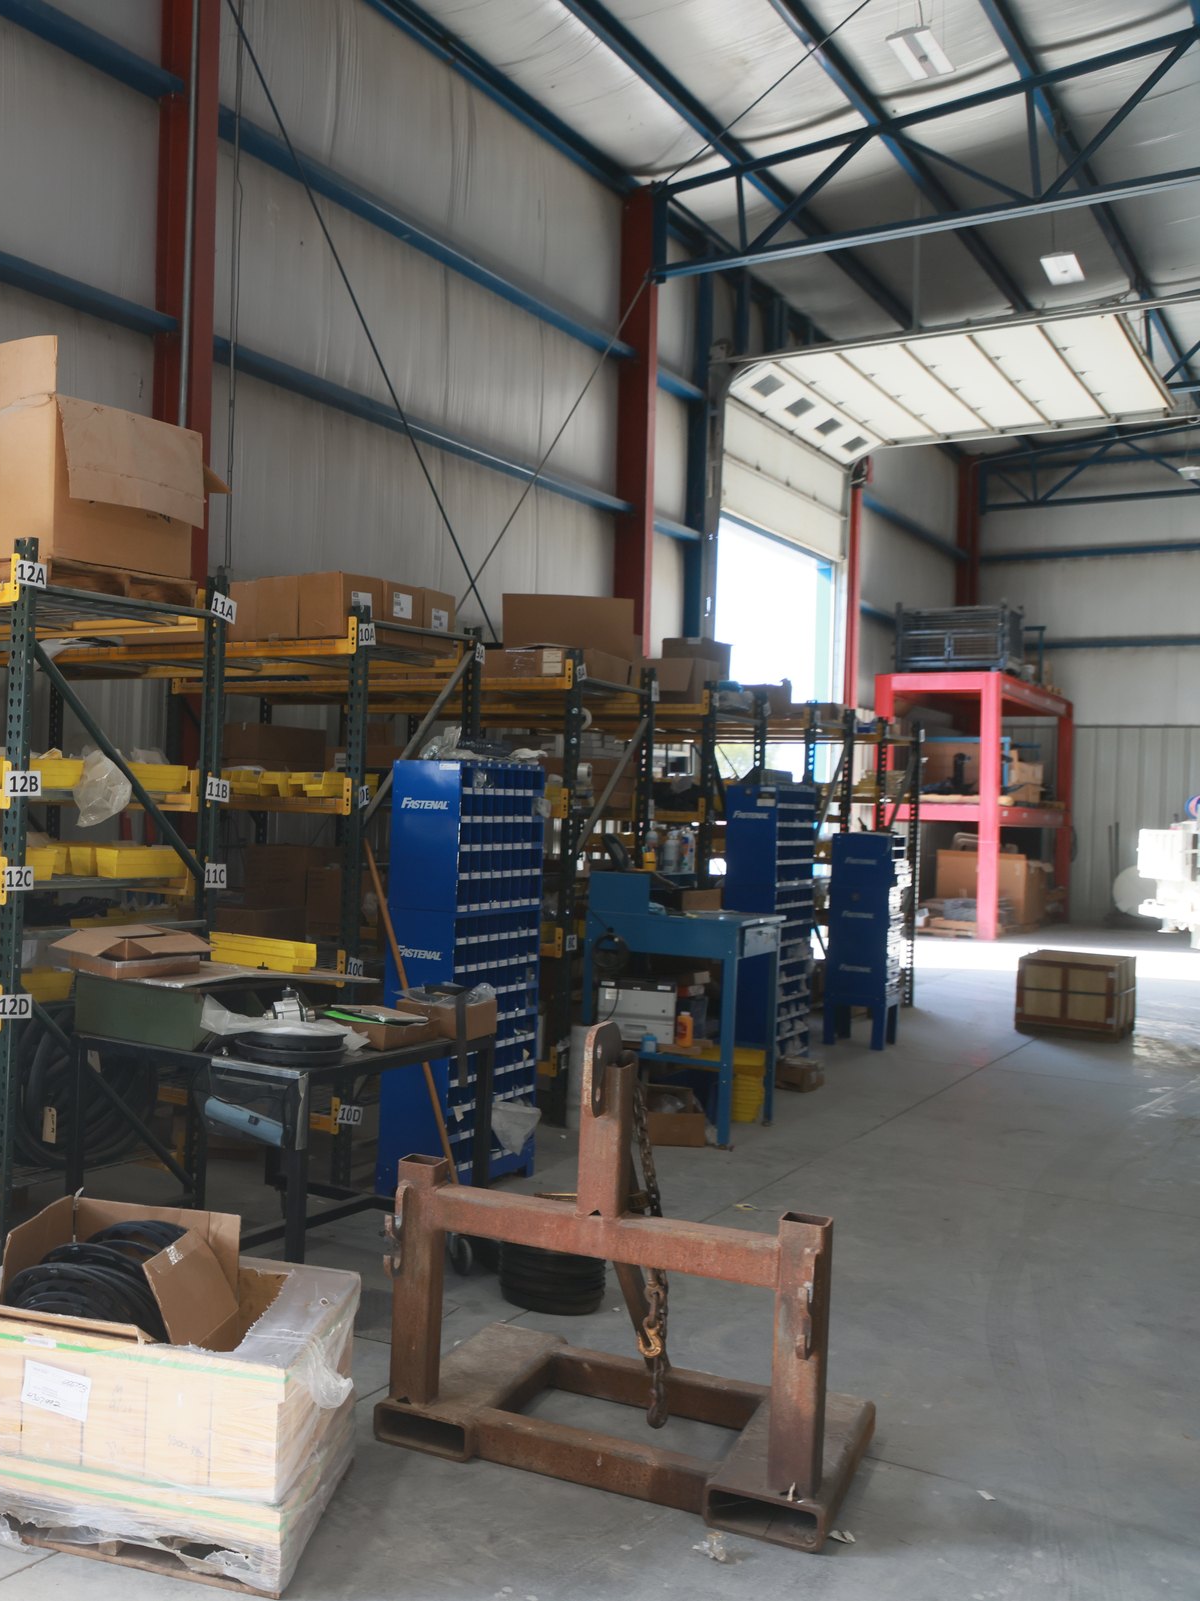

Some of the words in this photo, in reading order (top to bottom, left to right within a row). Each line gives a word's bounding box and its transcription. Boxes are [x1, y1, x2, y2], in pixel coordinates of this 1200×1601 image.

[18, 563, 45, 585] 12A
[212, 597, 233, 620] 11A
[359, 627, 375, 642] 10A
[9, 775, 39, 793] 12B
[207, 781, 228, 799] 11B
[401, 797, 449, 810] FASTENAL
[6, 870, 32, 888] 12C
[205, 868, 225, 884] 11C
[348, 962, 363, 976] 10C
[338, 1107, 361, 1122] 10D
